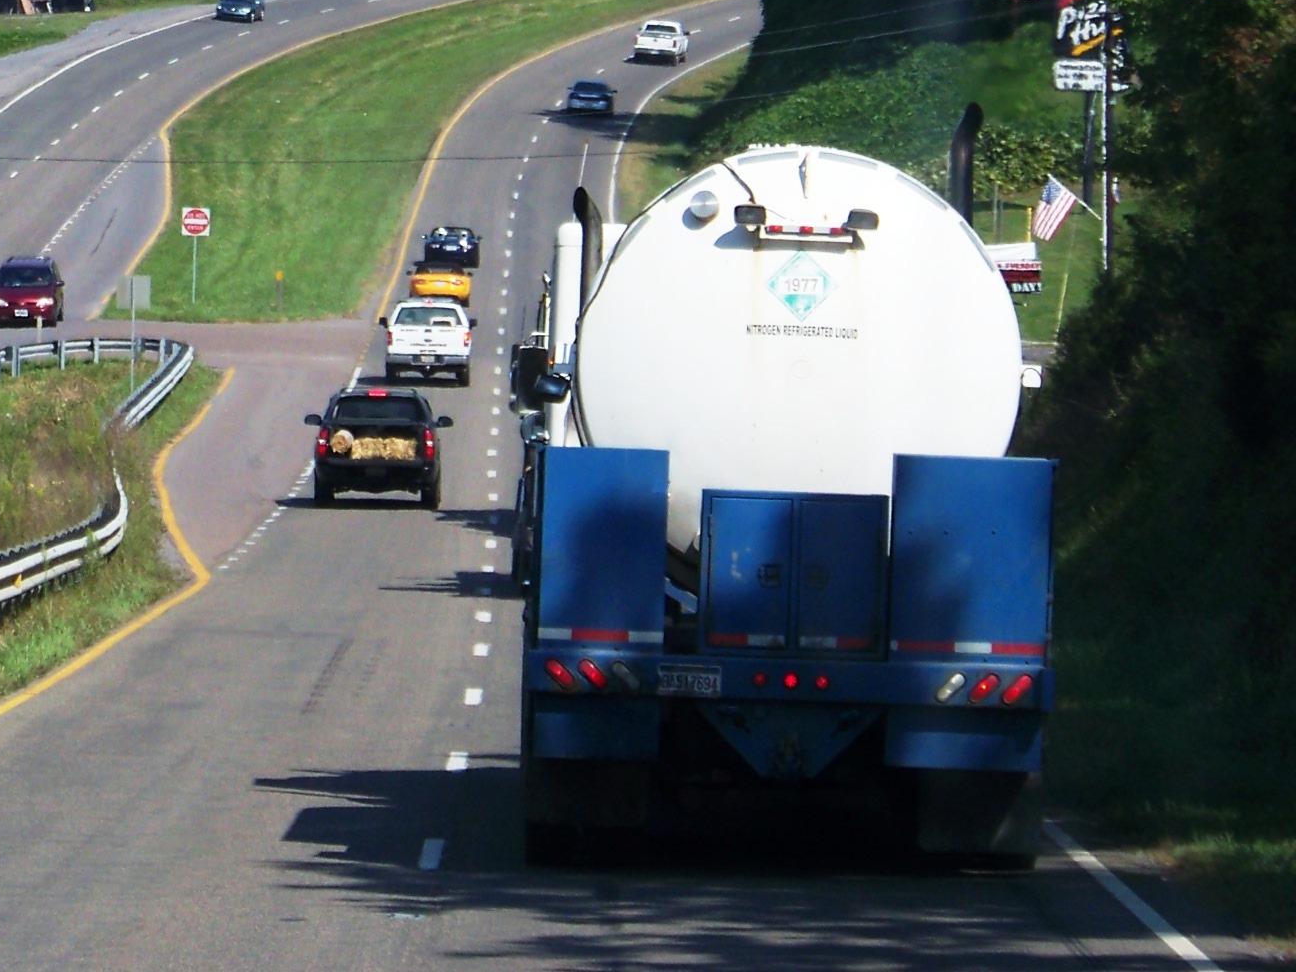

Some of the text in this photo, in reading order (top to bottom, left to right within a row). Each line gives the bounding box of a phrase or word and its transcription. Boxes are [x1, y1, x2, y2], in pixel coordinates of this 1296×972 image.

[785, 278, 819, 292] 1977
[746, 324, 859, 340] NITROGEN REFRIGERATED LIQUID
